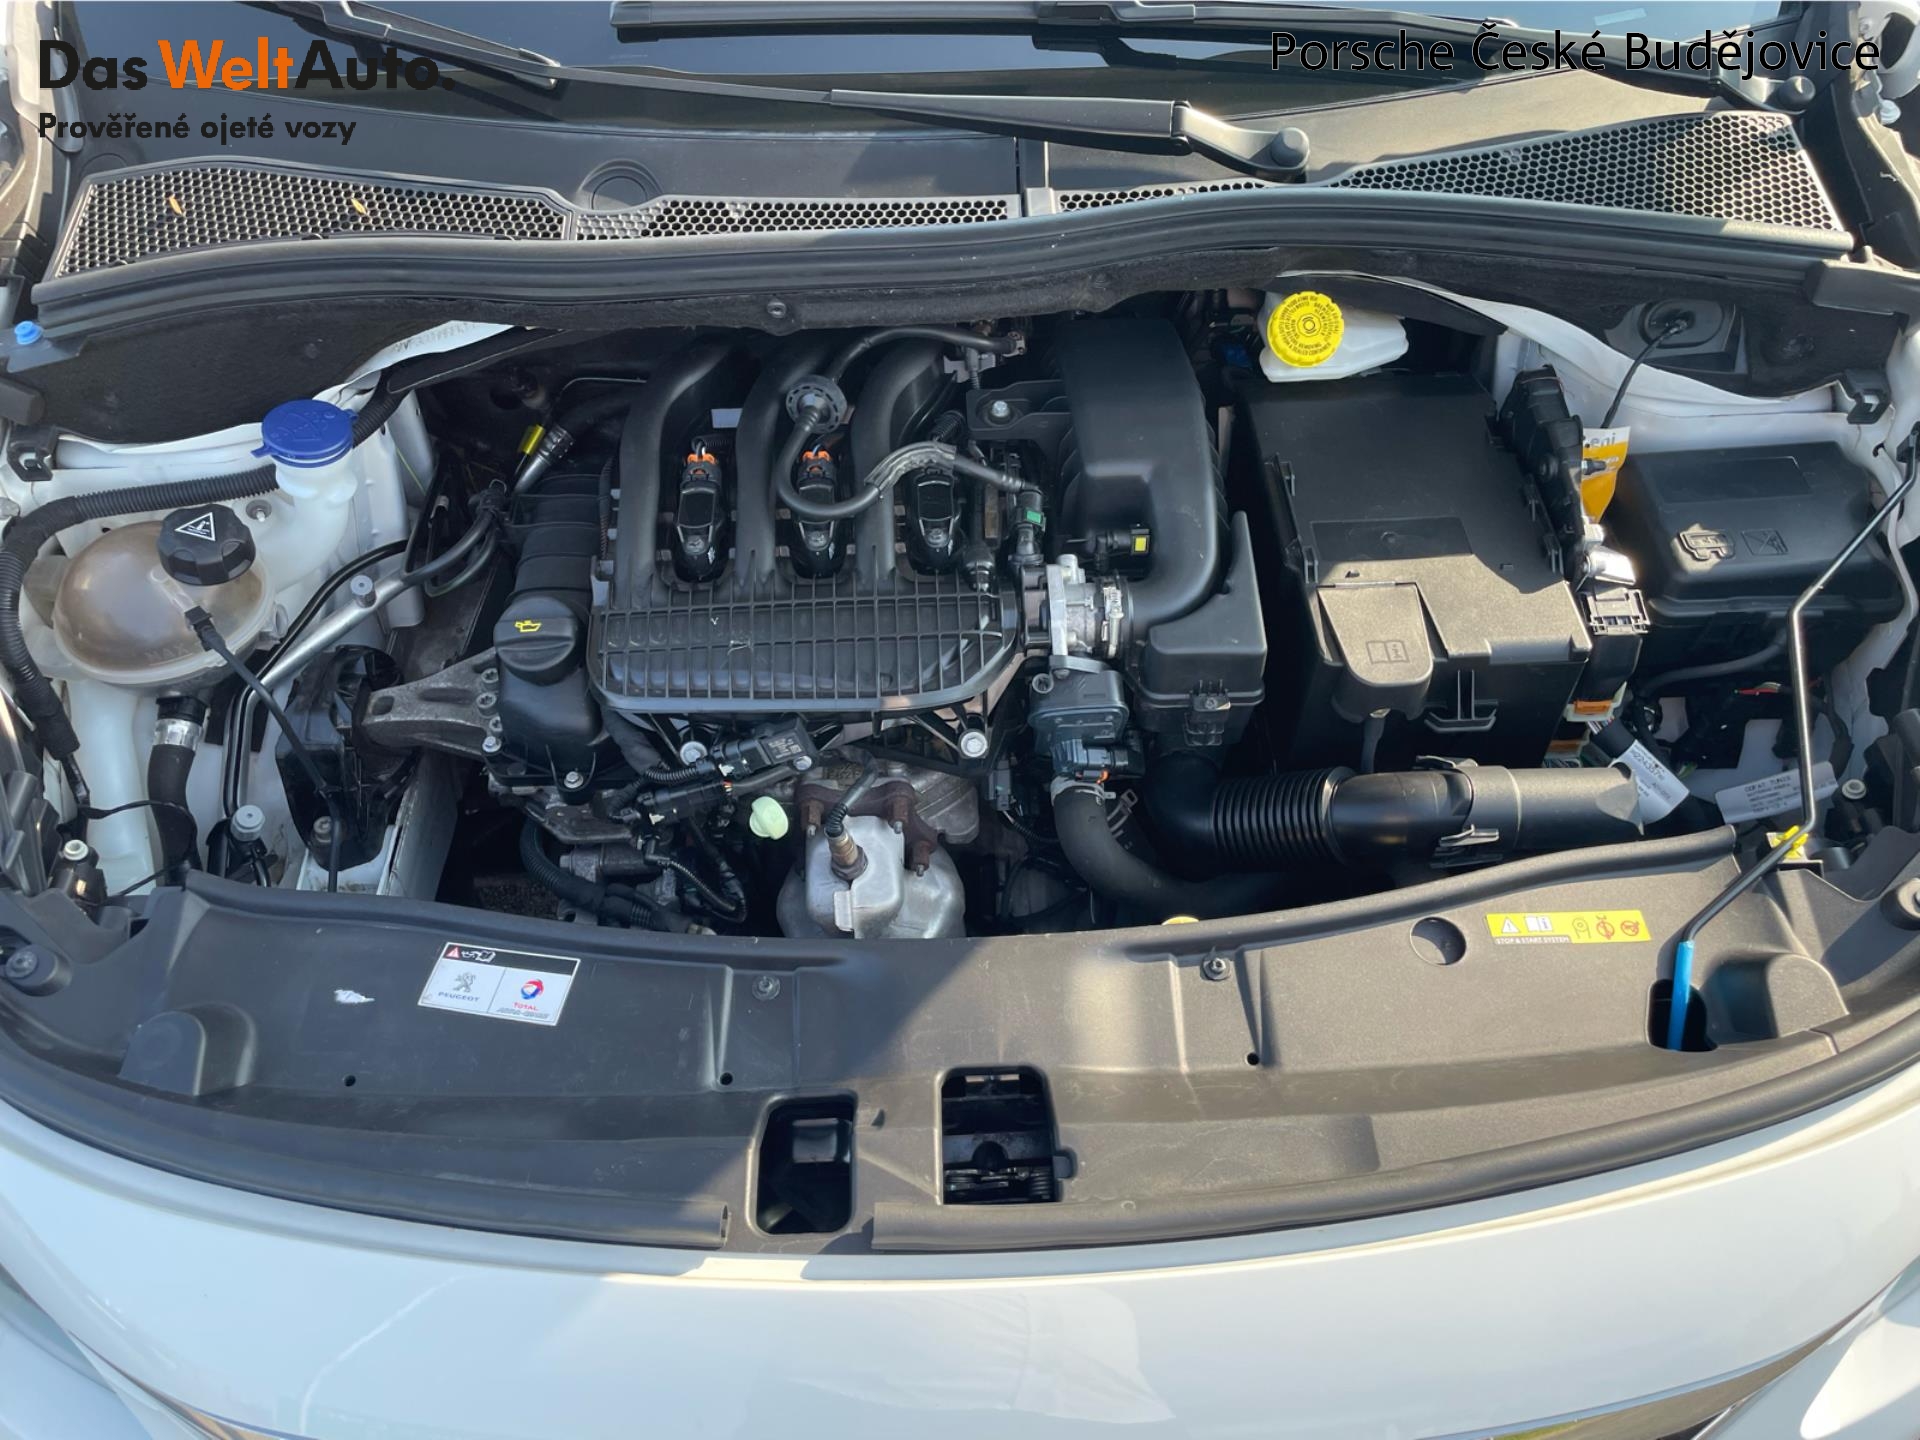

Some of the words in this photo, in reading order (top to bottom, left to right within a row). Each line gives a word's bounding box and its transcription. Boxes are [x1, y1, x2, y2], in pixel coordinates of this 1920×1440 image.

[1495, 937, 1514, 945] STOP
[438, 991, 480, 1002] PEUGEOT
[513, 1001, 539, 1011] TOTAL
